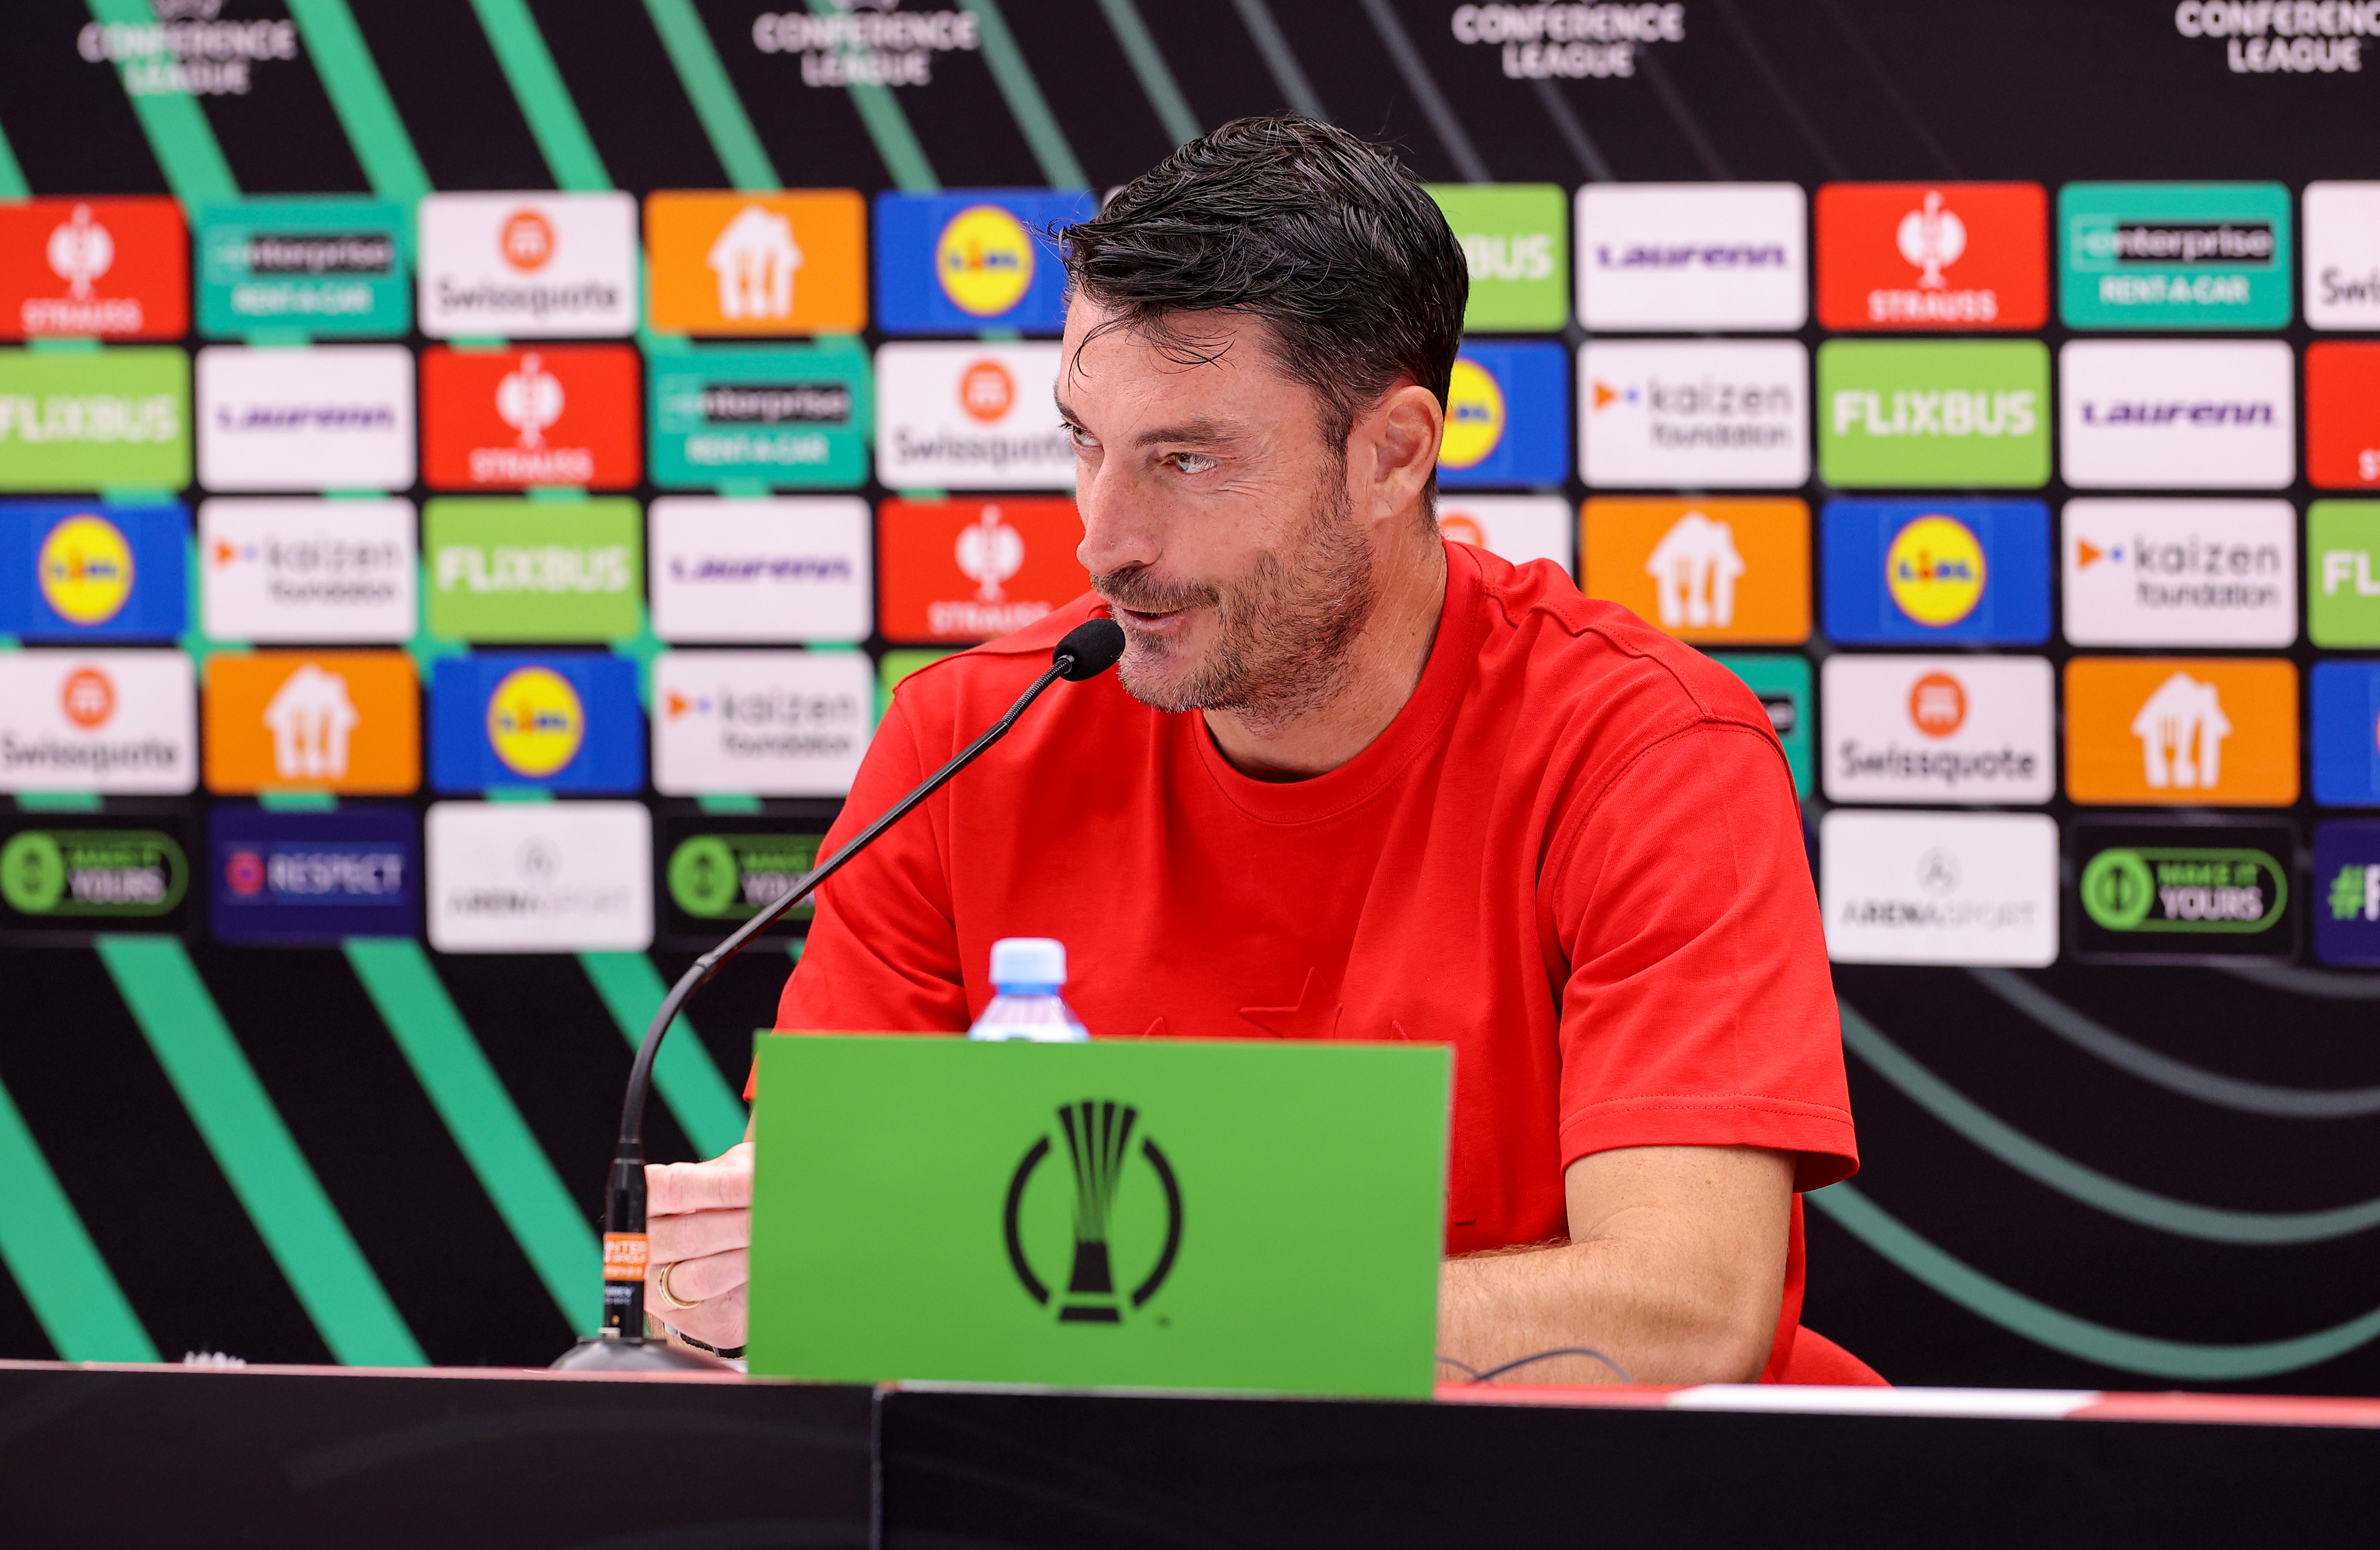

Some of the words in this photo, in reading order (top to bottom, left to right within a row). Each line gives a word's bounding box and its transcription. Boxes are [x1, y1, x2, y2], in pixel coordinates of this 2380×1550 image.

[78, 20, 296, 62] CONFERENCE
[753, 11, 979, 53] CONFERENCE
[1452, 3, 1685, 44] CONFERENCE
[801, 50, 931, 86] LEAGUE
[1502, 42, 1635, 78] LEAGUE
[2227, 36, 2362, 73] LEAGUE
[126, 61, 250, 94] LEAGUE
[1868, 289, 1998, 322] STRAUSS
[1649, 376, 1792, 416] kaizen
[1650, 421, 1792, 449] foundation
[469, 448, 594, 482] STRAUSS
[2133, 533, 2280, 575] kaizen
[2135, 581, 2280, 608] foundation
[721, 684, 857, 725] kaizen
[1840, 739, 2037, 788] Swissquote
[268, 853, 402, 895] RESPECT
[2159, 886, 2263, 920] YOURS
